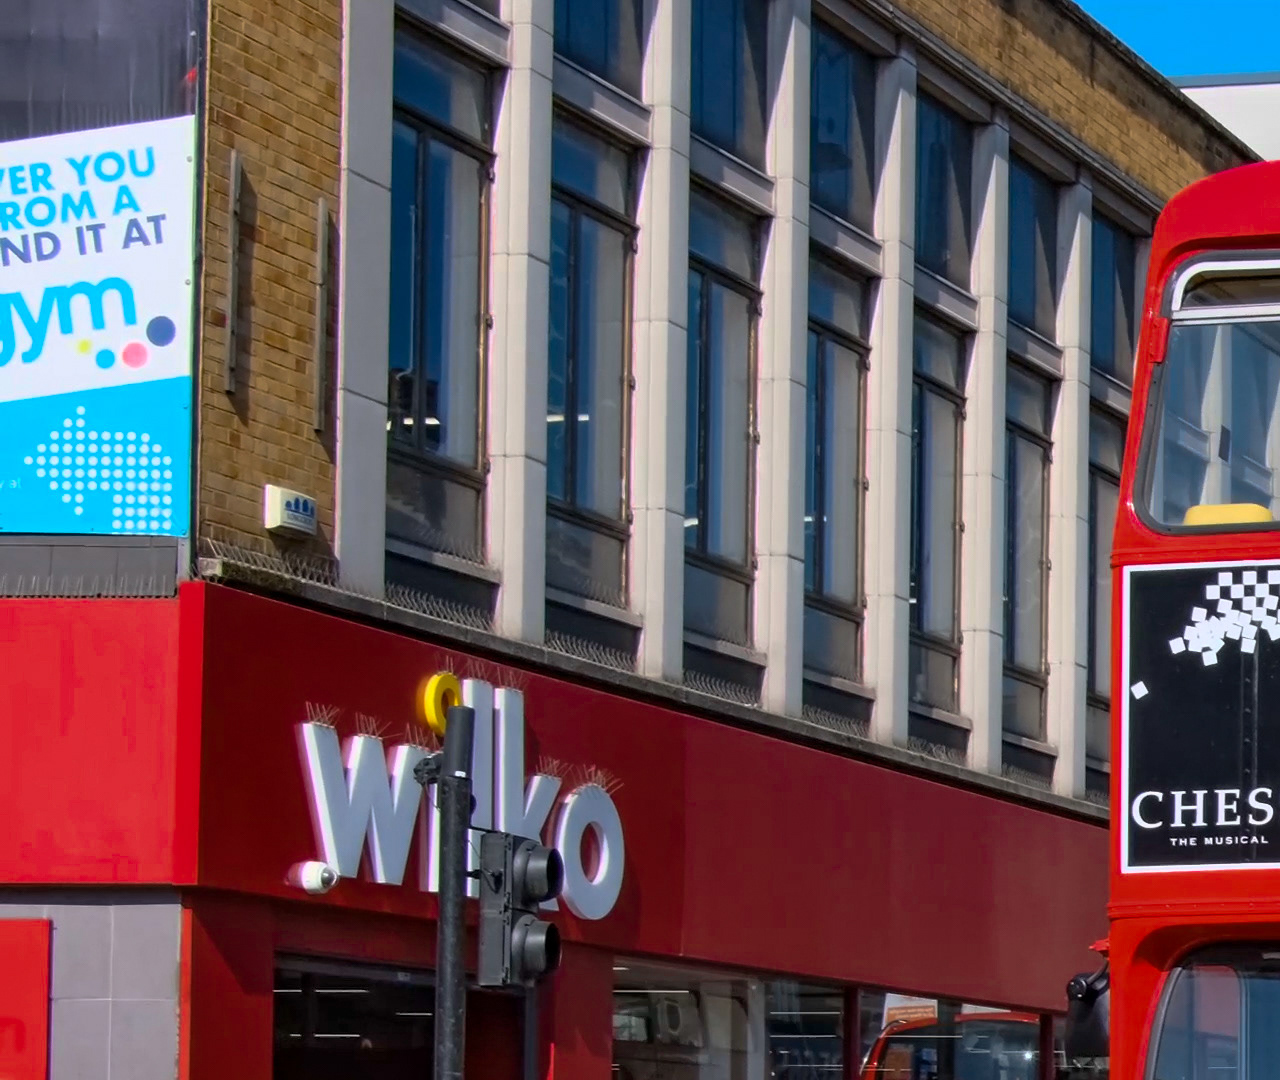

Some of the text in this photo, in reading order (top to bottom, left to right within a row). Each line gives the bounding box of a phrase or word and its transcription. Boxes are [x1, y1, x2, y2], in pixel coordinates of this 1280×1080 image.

[65, 146, 155, 187] YOU
[112, 184, 142, 216] A
[75, 222, 107, 256] IT
[121, 213, 167, 250] AT
[1170, 835, 1269, 846] THE MUSICAL
